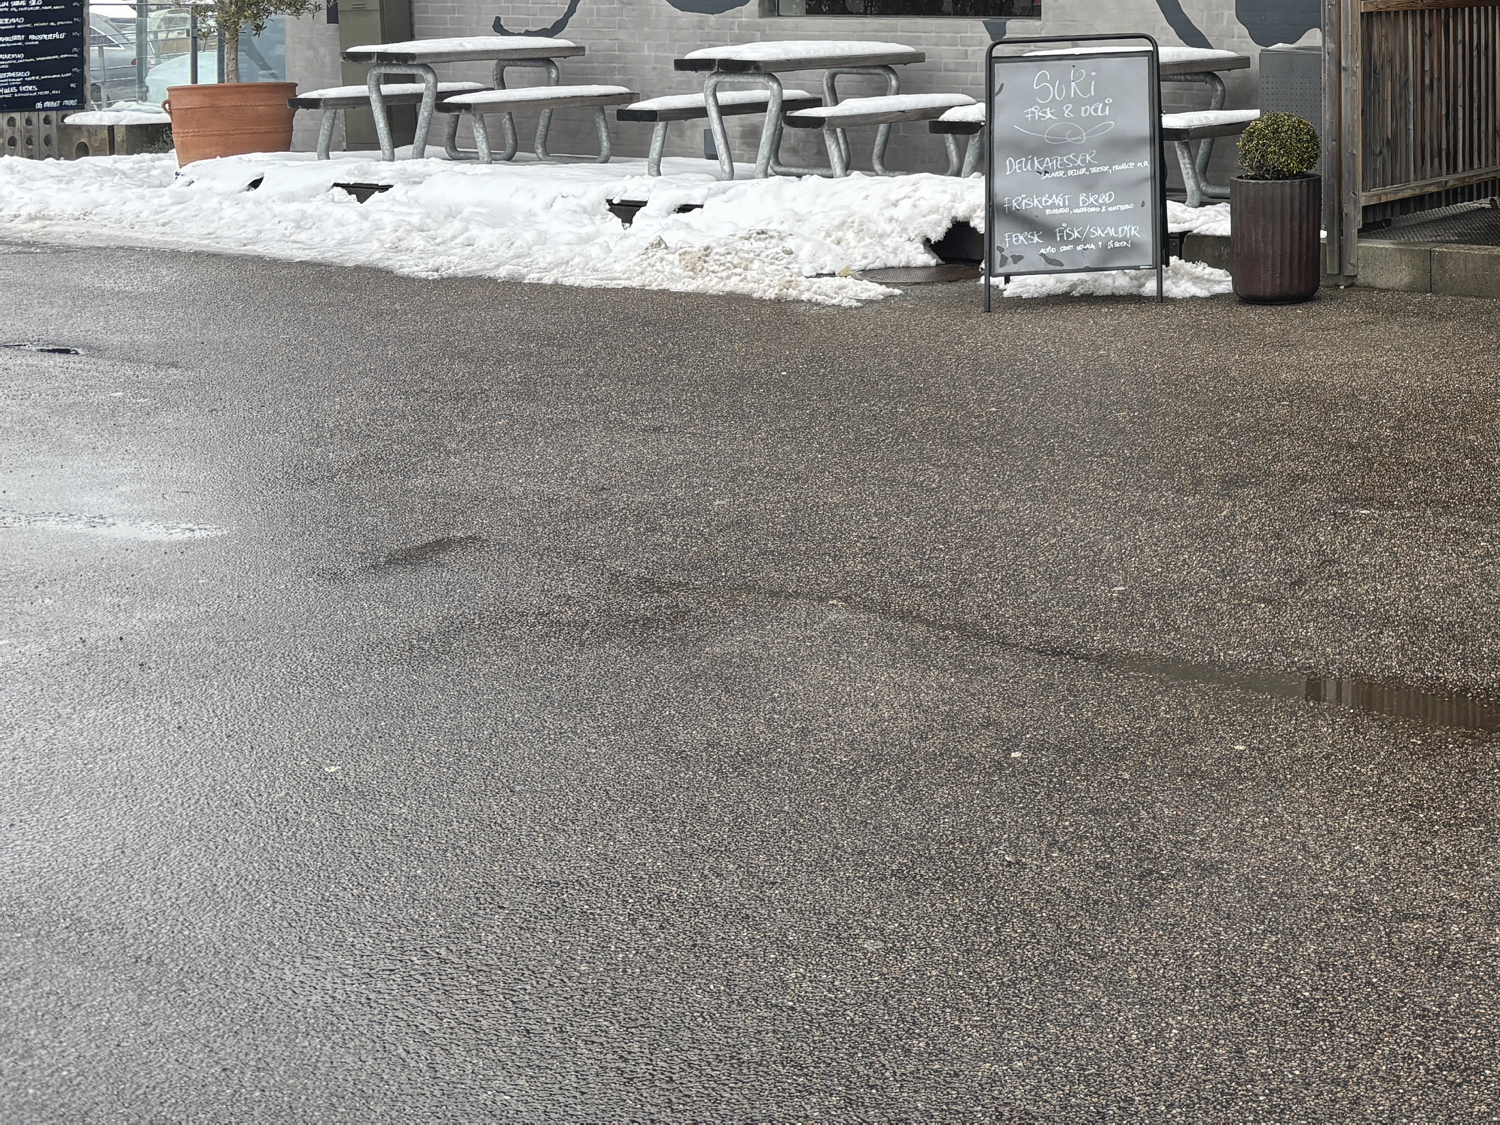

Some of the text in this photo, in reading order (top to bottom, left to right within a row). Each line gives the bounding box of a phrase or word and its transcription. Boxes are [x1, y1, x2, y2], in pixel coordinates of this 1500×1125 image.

[1063, 104, 1074, 117] &
[1079, 191, 1115, 207] BRØD
[1004, 231, 1044, 248] FERSK
